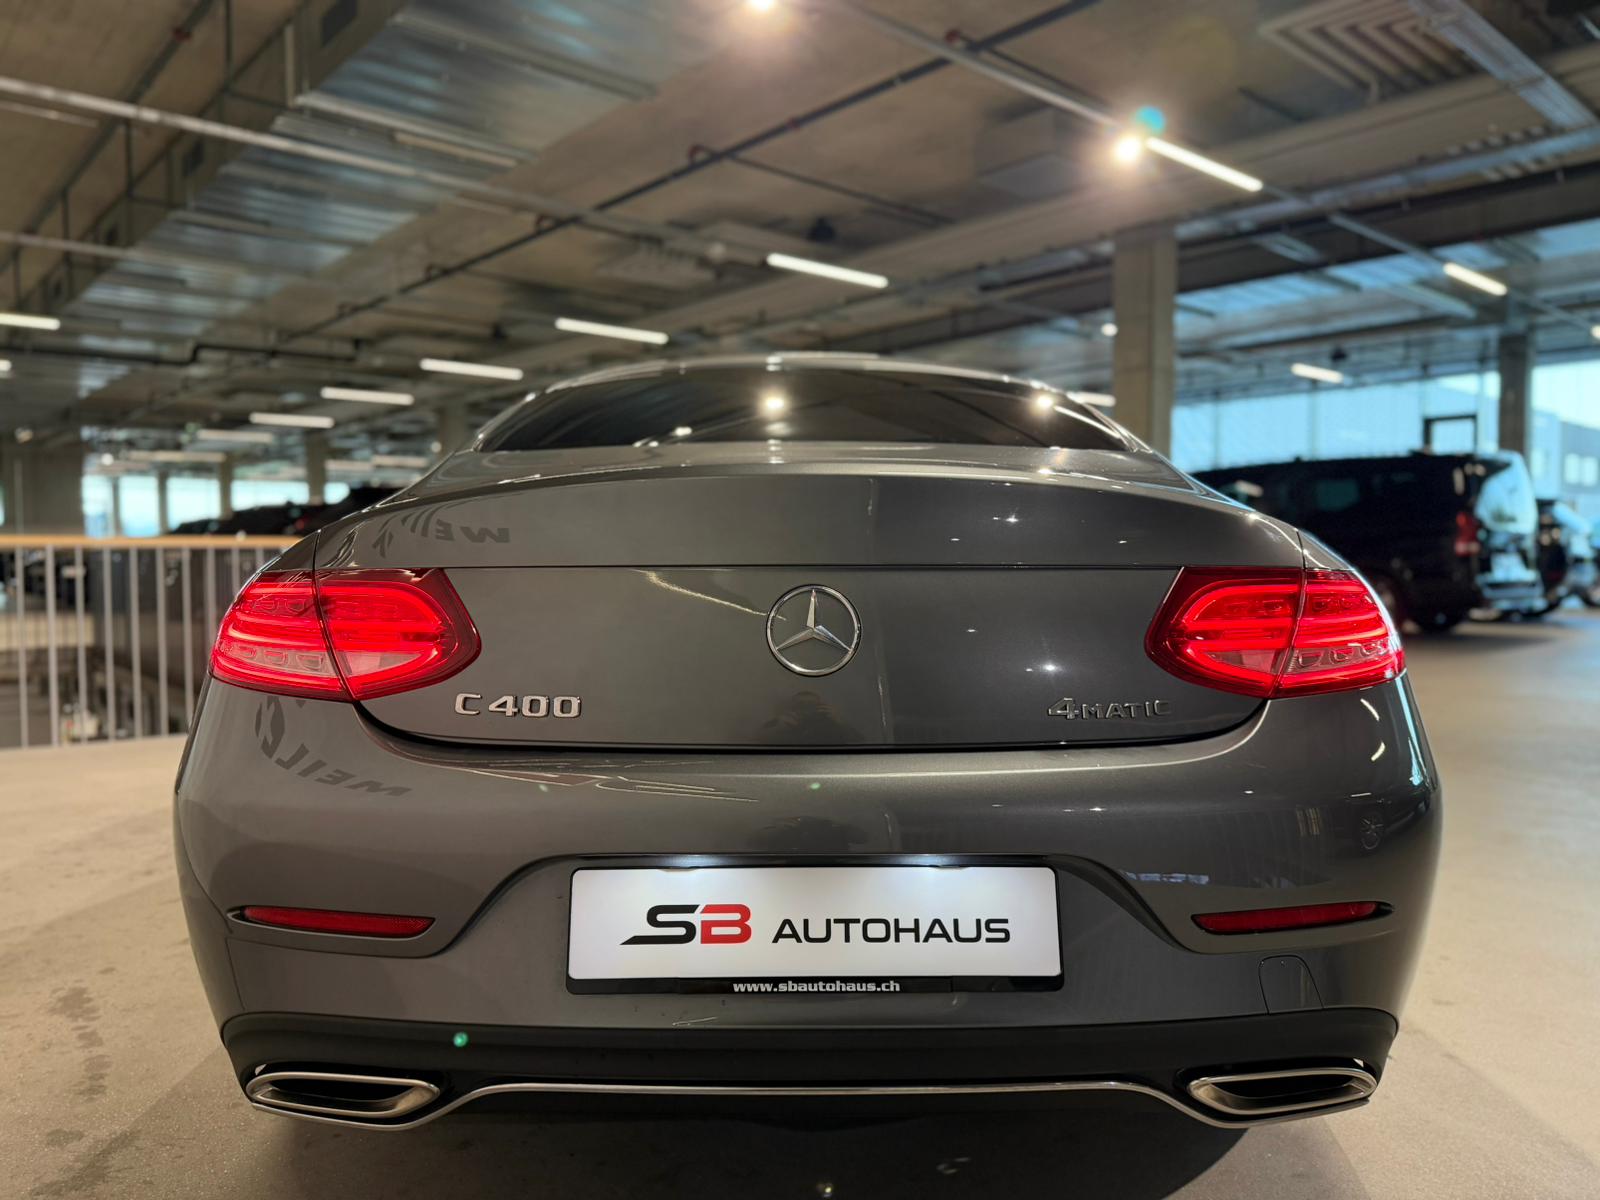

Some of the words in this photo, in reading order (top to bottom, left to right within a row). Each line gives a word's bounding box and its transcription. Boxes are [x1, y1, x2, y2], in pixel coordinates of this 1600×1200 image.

[454, 692, 482, 716] C
[488, 694, 581, 718] 400
[1048, 697, 1172, 720] 4MATIC
[619, 903, 752, 946] SB
[771, 917, 1012, 944] AUTOHAUS
[732, 980, 901, 993] www.sbautohaus.ch
